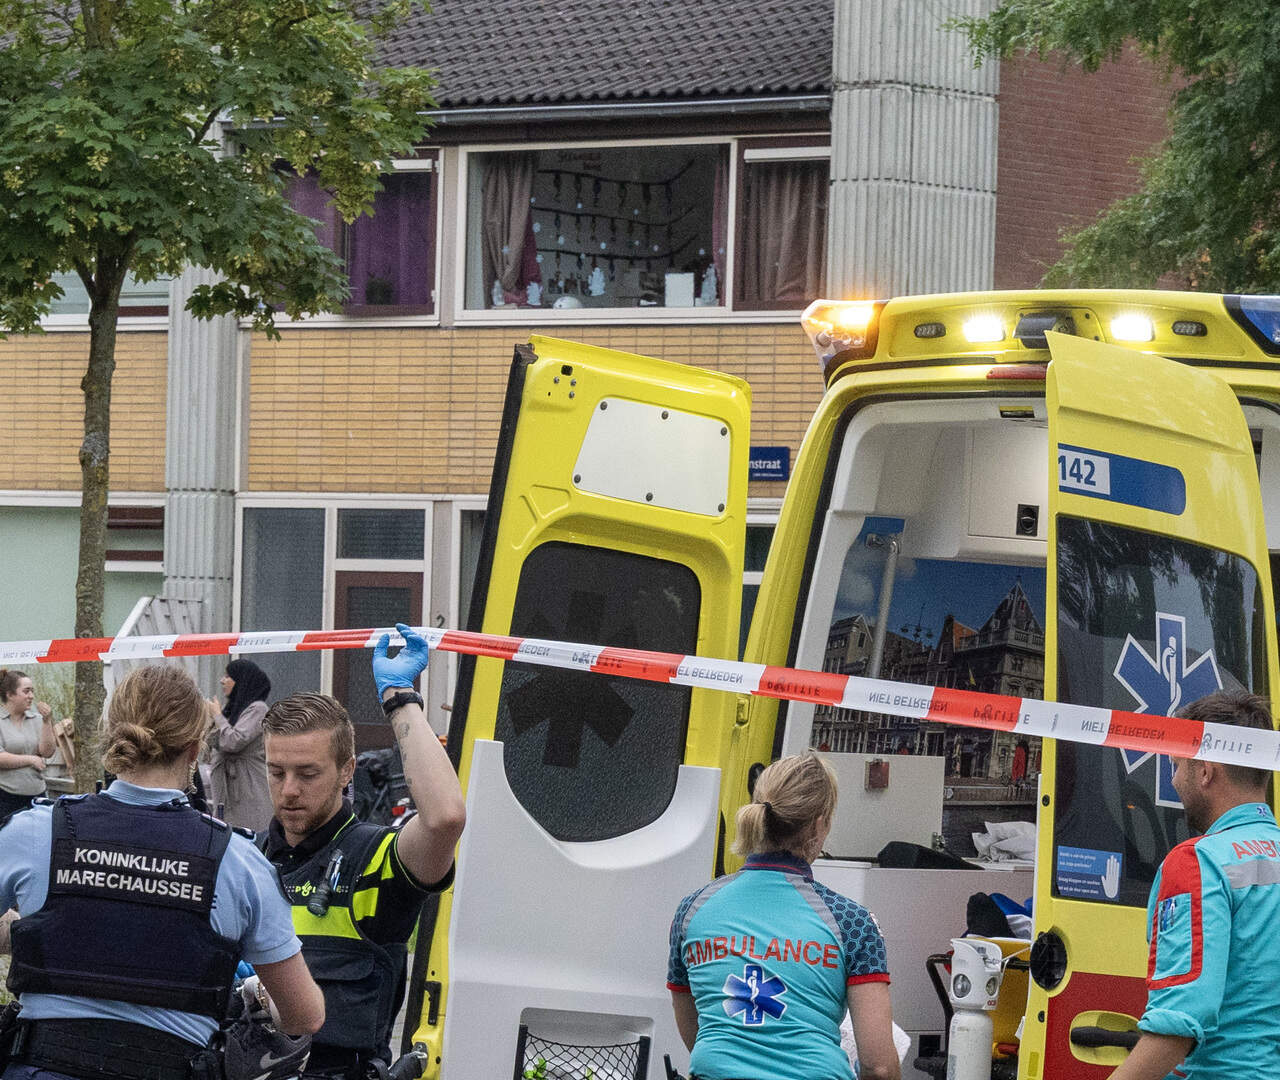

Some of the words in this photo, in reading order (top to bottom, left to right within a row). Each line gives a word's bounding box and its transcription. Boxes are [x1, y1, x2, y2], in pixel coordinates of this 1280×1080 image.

[1058, 455, 1096, 486] 142
[436, 614, 446, 628] 2
[74, 848, 189, 876] KONINKLIJKE
[56, 869, 203, 901] MARECHAUSSEE
[686, 935, 839, 969] AMBULANCE
